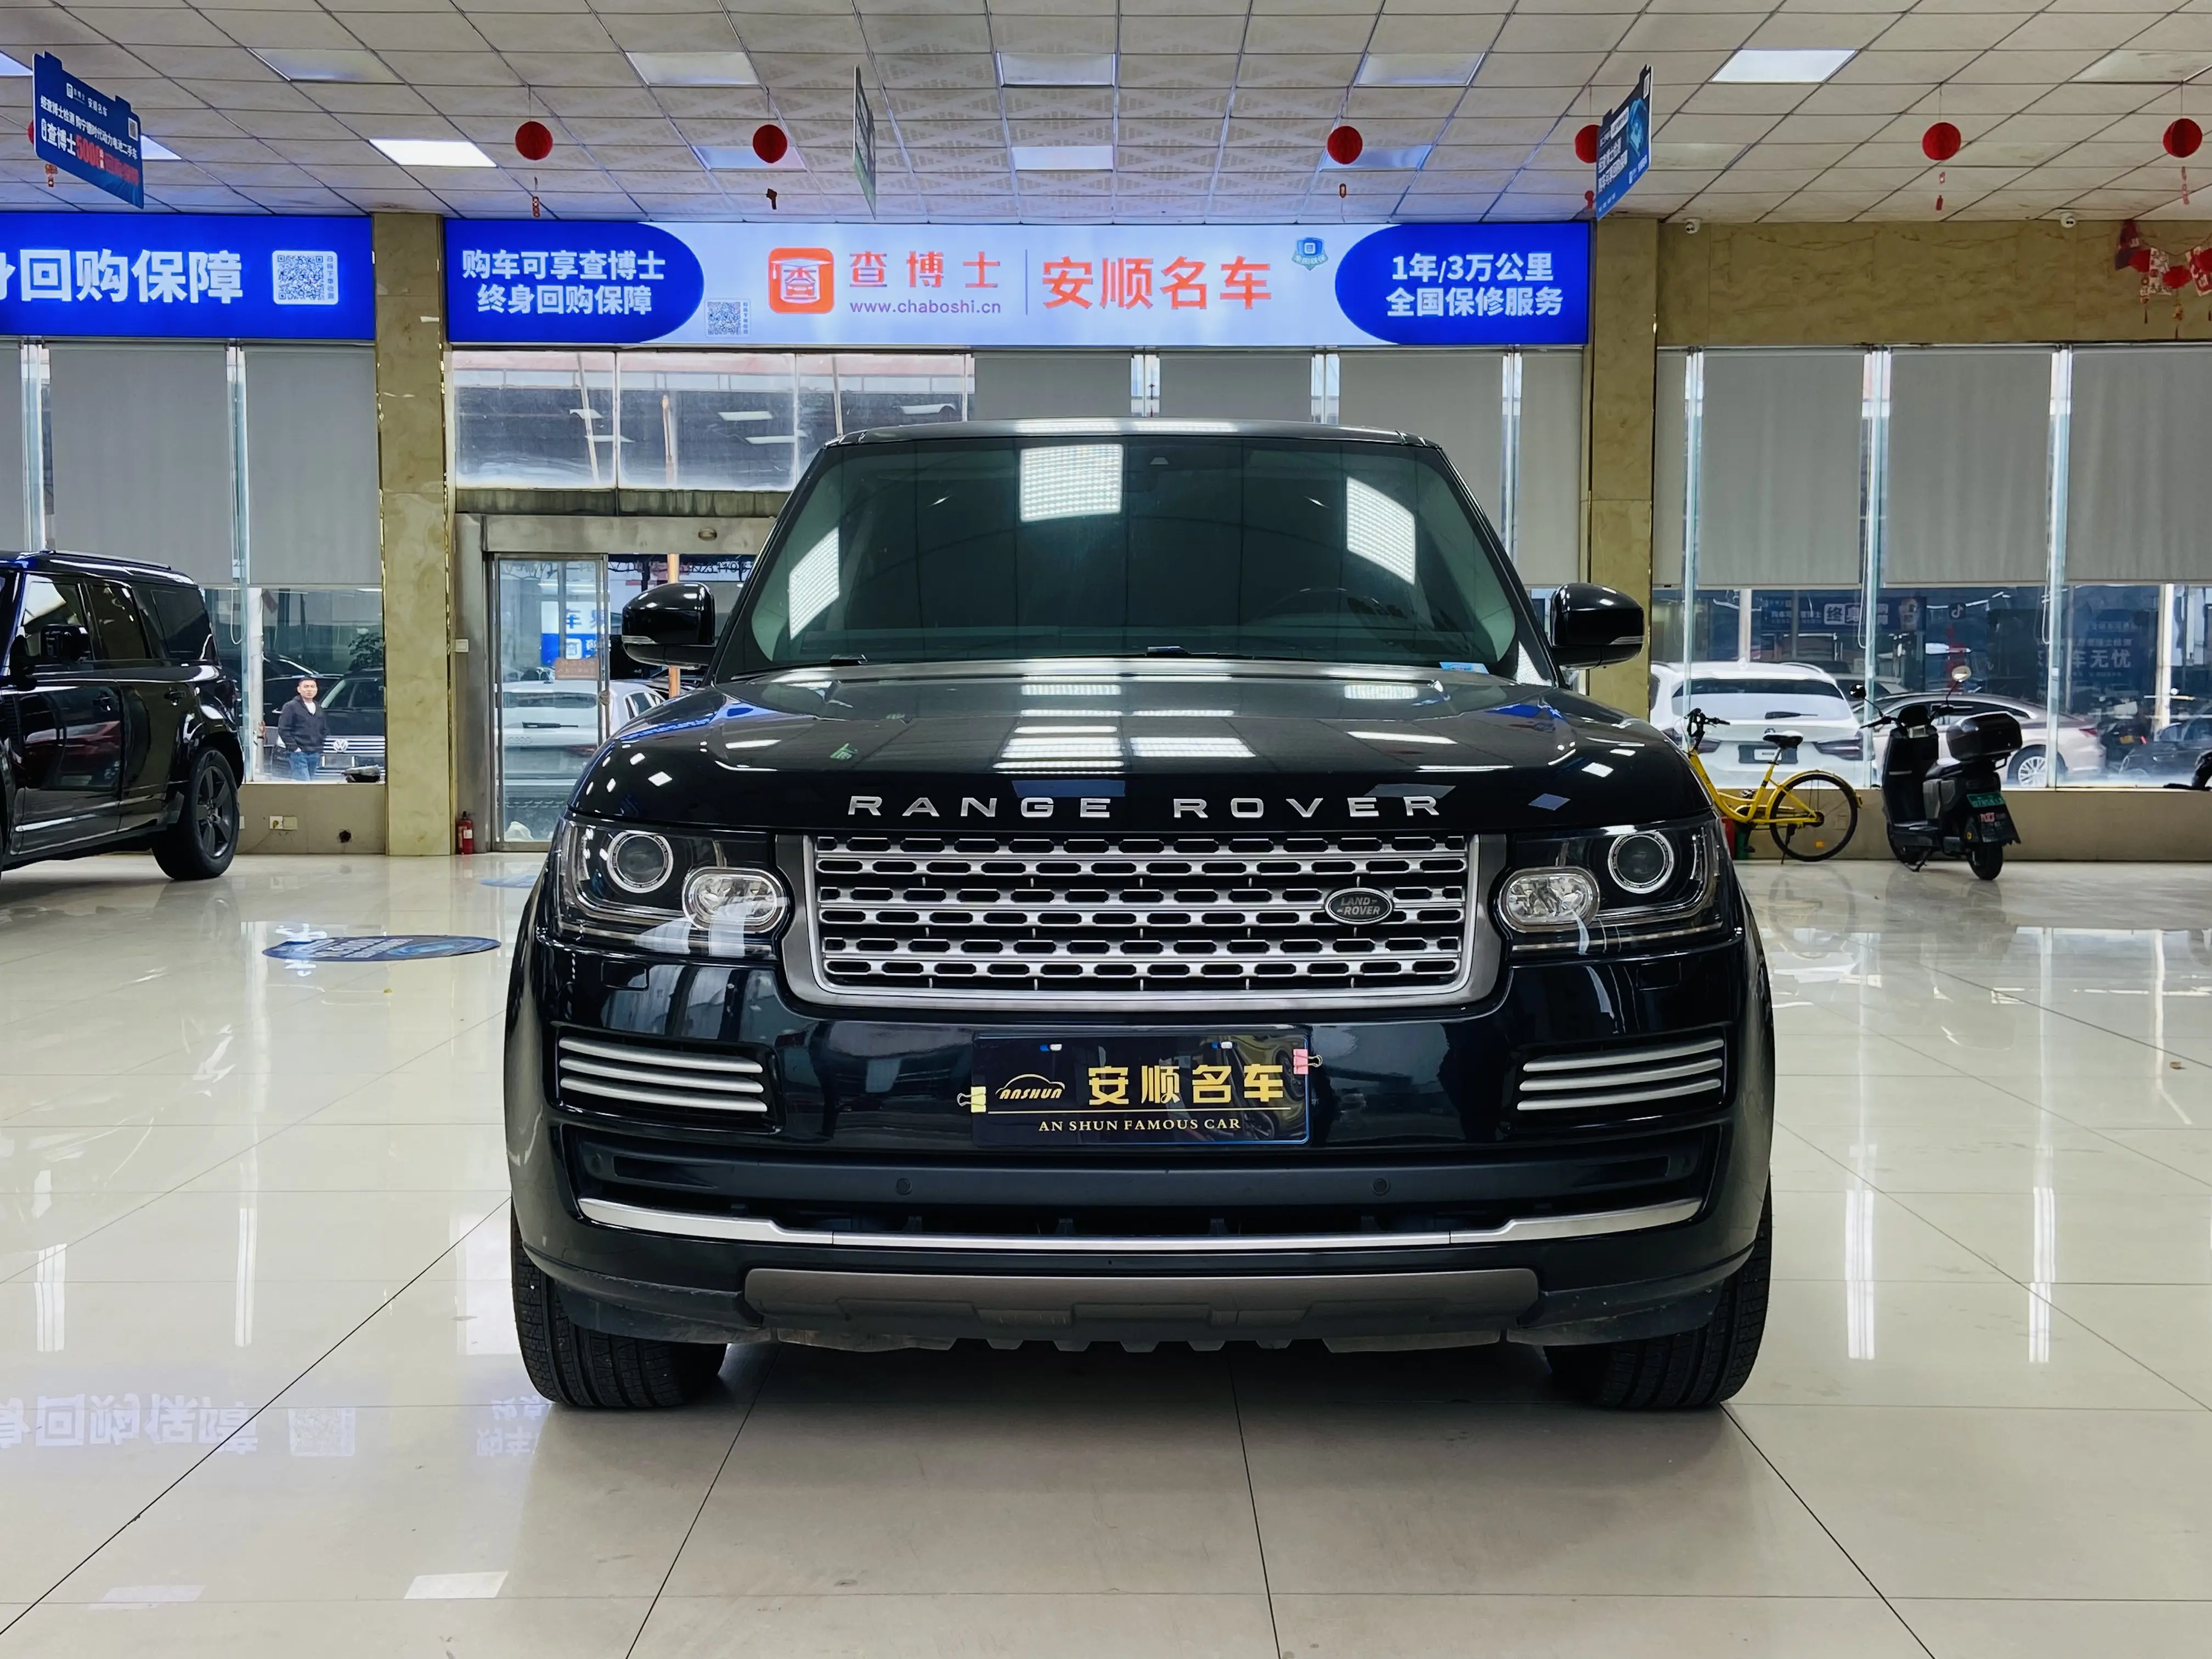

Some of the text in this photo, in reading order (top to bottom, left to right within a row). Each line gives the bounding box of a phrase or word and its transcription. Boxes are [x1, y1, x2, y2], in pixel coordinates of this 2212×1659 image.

[462, 250, 665, 280] 购车可享查博士
[850, 251, 1000, 288] 查博士
[1391, 253, 1554, 284] 1年/3万公里
[1043, 256, 1272, 309] 安顺名车
[477, 285, 652, 315] 终身回购保障
[850, 300, 1001, 313] www.chaboshi.cn
[1385, 287, 1563, 316] 全国保修服务
[848, 796, 1440, 818] RANGE ROVER
[1340, 897, 1370, 906] LAND
[1344, 906, 1381, 915] ROVER
[1088, 1063, 1283, 1105] 安顺名车
[1039, 1119, 1242, 1131] AN SHUN FAMOUS CAR
